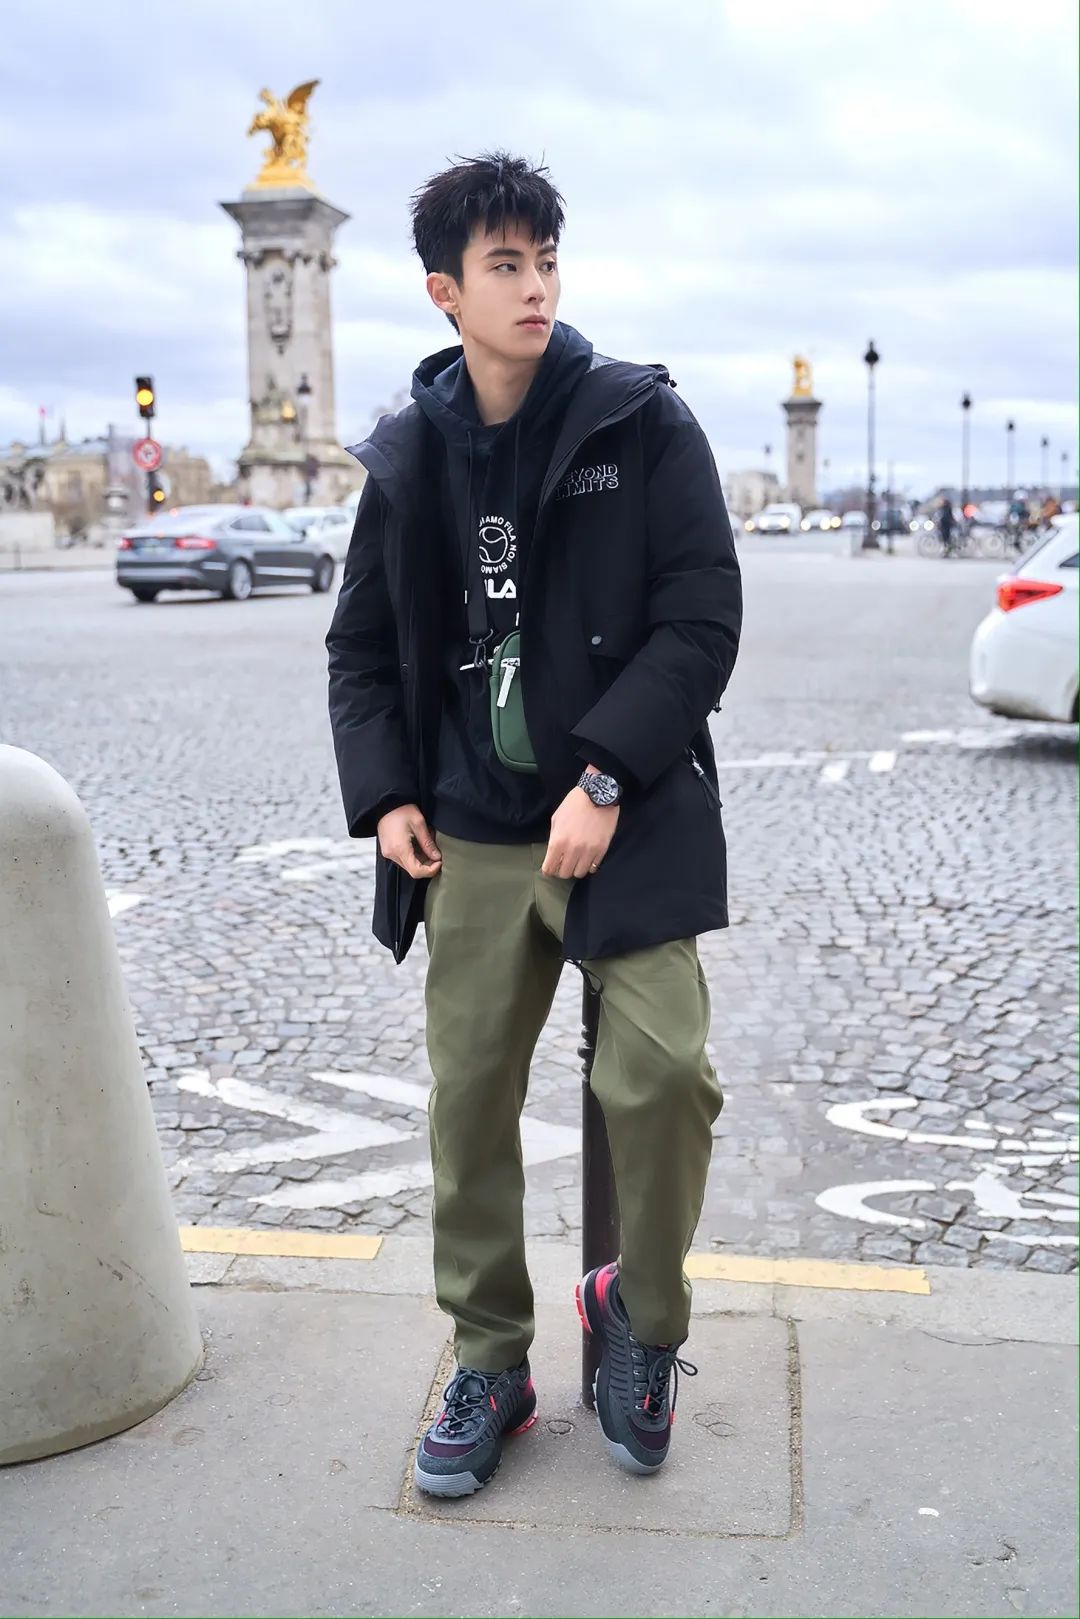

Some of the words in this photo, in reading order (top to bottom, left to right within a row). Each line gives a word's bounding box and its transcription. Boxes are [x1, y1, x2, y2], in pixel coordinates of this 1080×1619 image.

[504, 520, 517, 542] FILA
[506, 544, 517, 563] NOI
[480, 561, 508, 574] SIAMO
